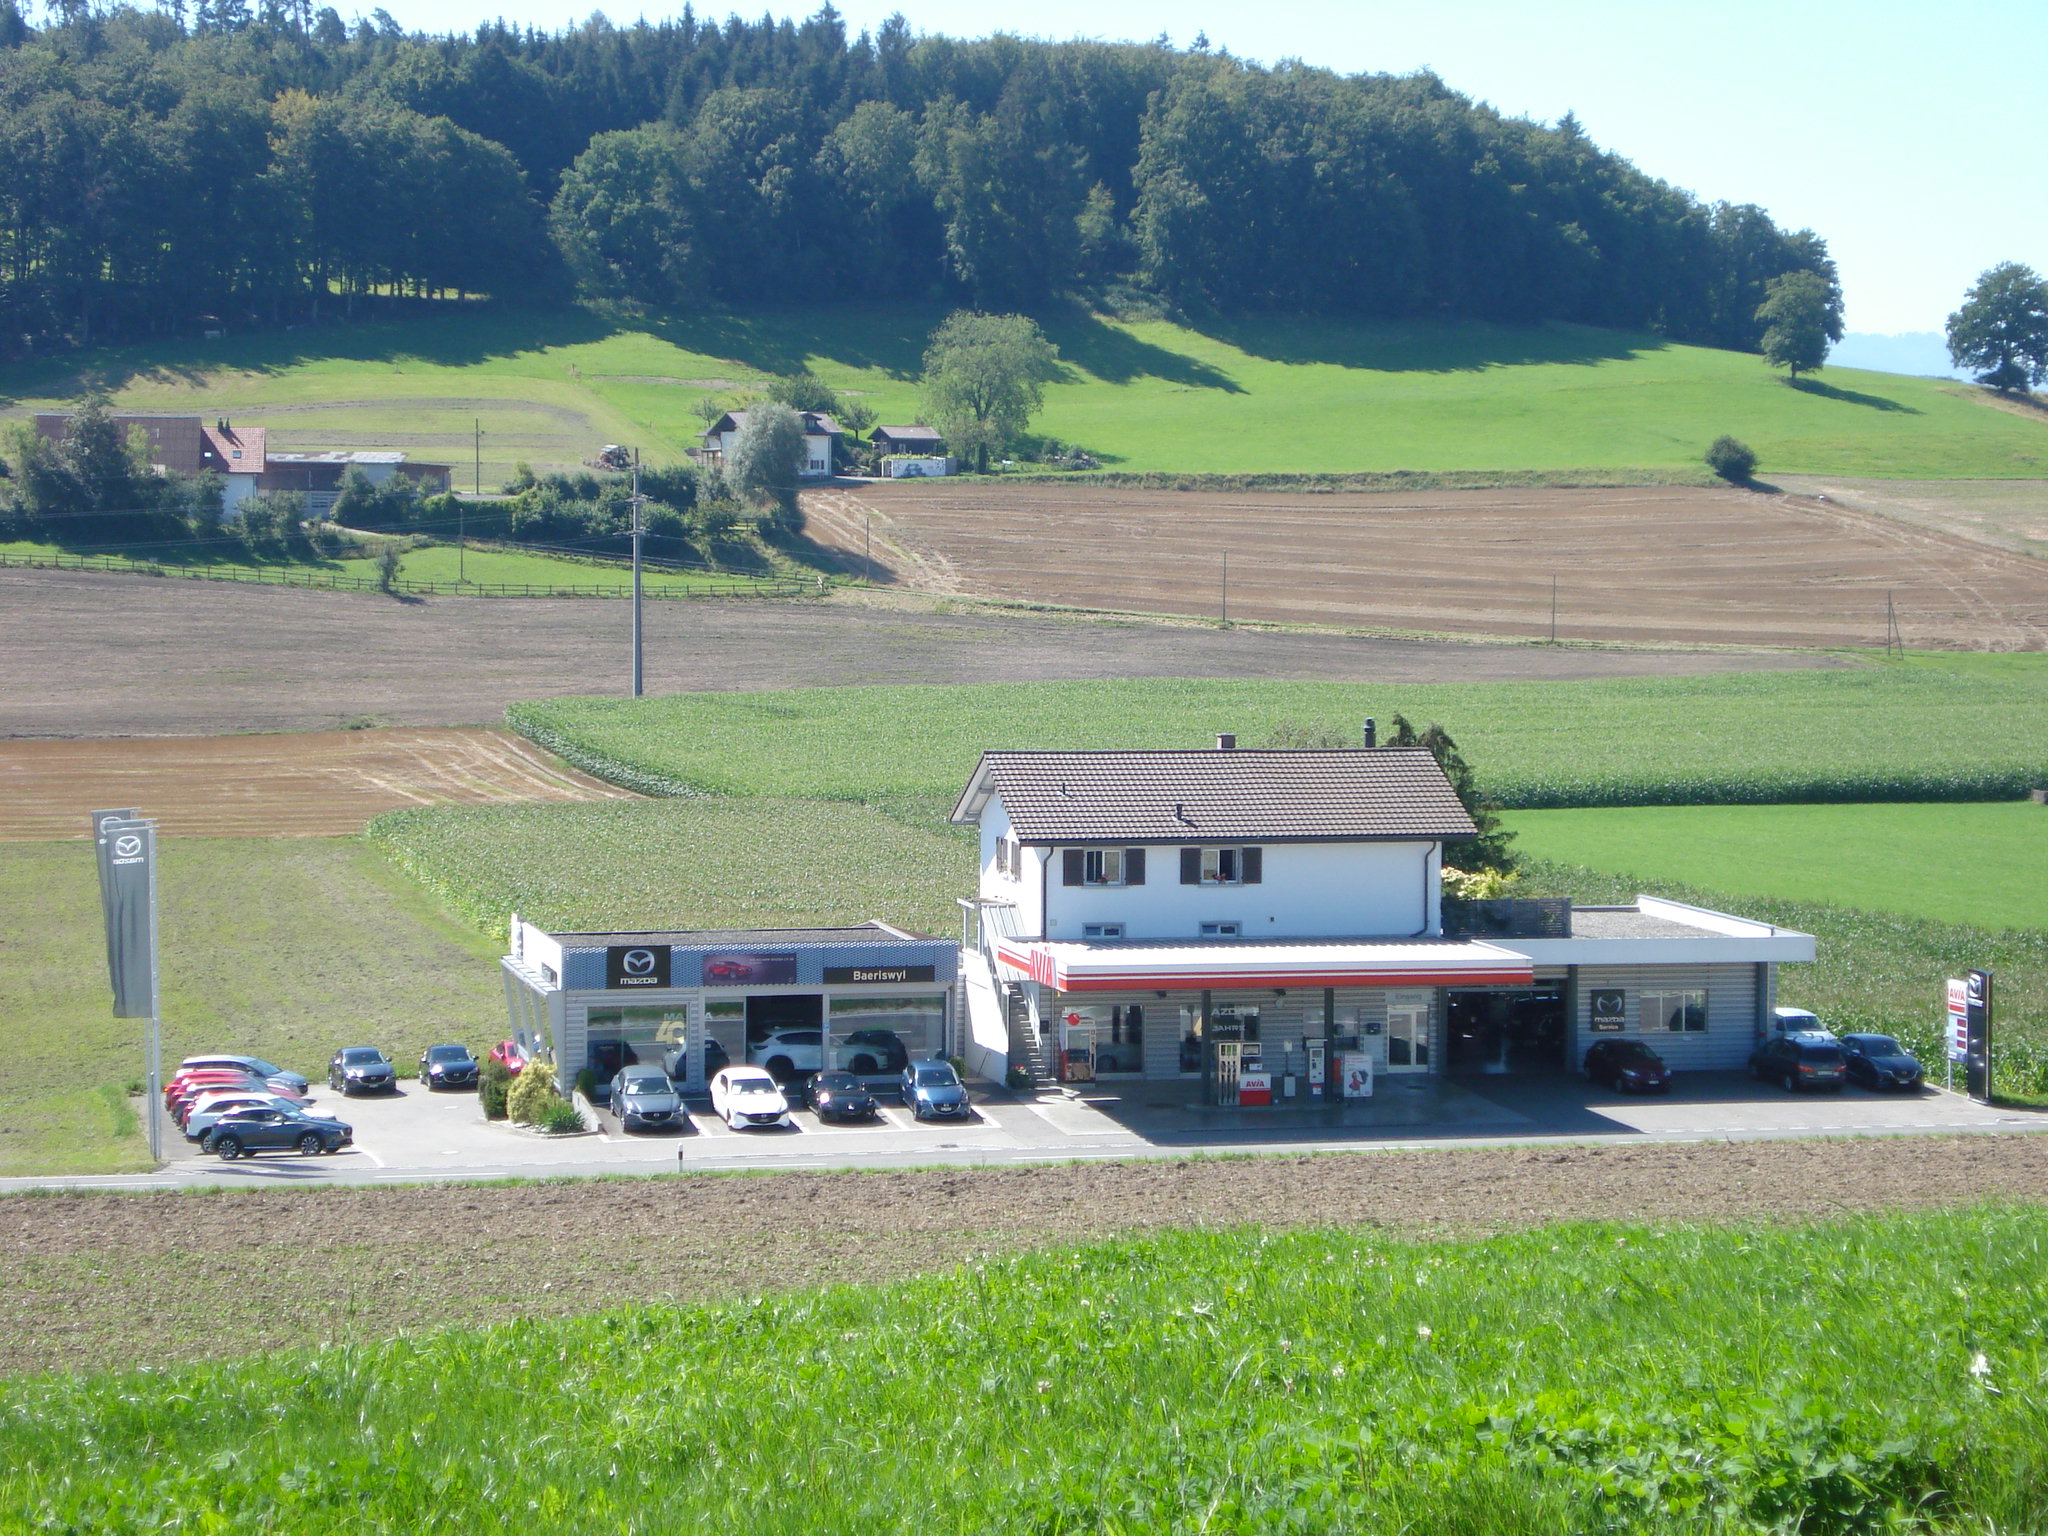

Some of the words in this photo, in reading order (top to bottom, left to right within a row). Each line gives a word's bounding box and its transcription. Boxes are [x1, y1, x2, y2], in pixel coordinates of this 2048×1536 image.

[1030, 947, 1055, 988] AVIA
[853, 970, 906, 982] Baeriswyl
[1950, 987, 1966, 1001] AVIA
[1246, 1079, 1265, 1088] AVIA
